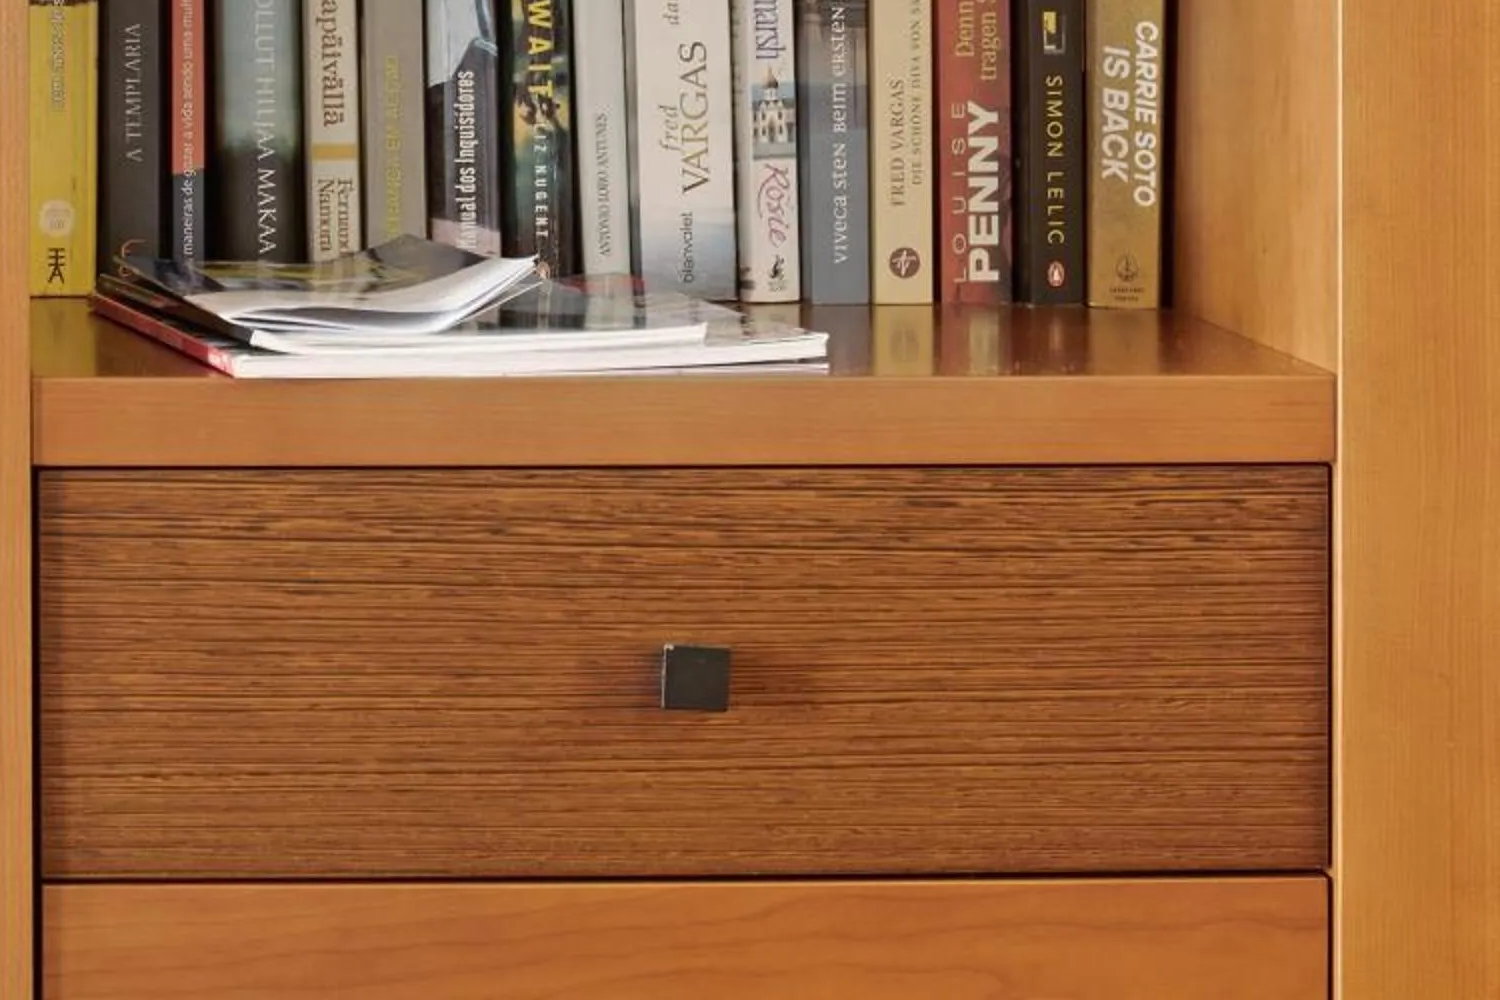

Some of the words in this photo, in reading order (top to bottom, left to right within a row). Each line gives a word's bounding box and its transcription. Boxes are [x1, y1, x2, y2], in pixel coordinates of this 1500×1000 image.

[182, 30, 193, 59] uma
[909, 19, 922, 50] VON
[953, 0, 975, 58] Denn
[979, 11, 1001, 81] tragen
[124, 23, 143, 144] TEMPLARIA
[180, 61, 193, 99] sendo
[909, 55, 922, 89] DIVA
[1101, 44, 1131, 80] IS
[1135, 20, 1159, 125] CARRIE
[180, 101, 193, 129] vida
[253, 77, 277, 160] HILJAA
[453, 70, 478, 164] Inquisidores
[533, 122, 548, 153] LIZ
[656, 104, 681, 153] fred
[677, 40, 710, 194] VARGAS
[888, 79, 906, 152] VARGAS
[908, 95, 923, 155] SCHÖNE
[1045, 74, 1064, 158] SIMON
[1100, 87, 1130, 185] BACK
[125, 148, 144, 163] A
[181, 178, 193, 195] de
[454, 167, 476, 193] dos
[889, 157, 906, 207] FRED
[909, 162, 923, 186] DIE
[1132, 130, 1158, 207] SOTO
[257, 167, 277, 255] MAKAA
[337, 177, 356, 259] Fernand
[454, 195, 476, 249] Manual
[534, 164, 549, 239] NUGENT
[756, 163, 791, 248] Rosie
[950, 102, 967, 283] LOUISE
[966, 99, 1000, 283] PENNY
[1046, 170, 1065, 246] LELIC
[181, 196, 194, 256] maneiras
